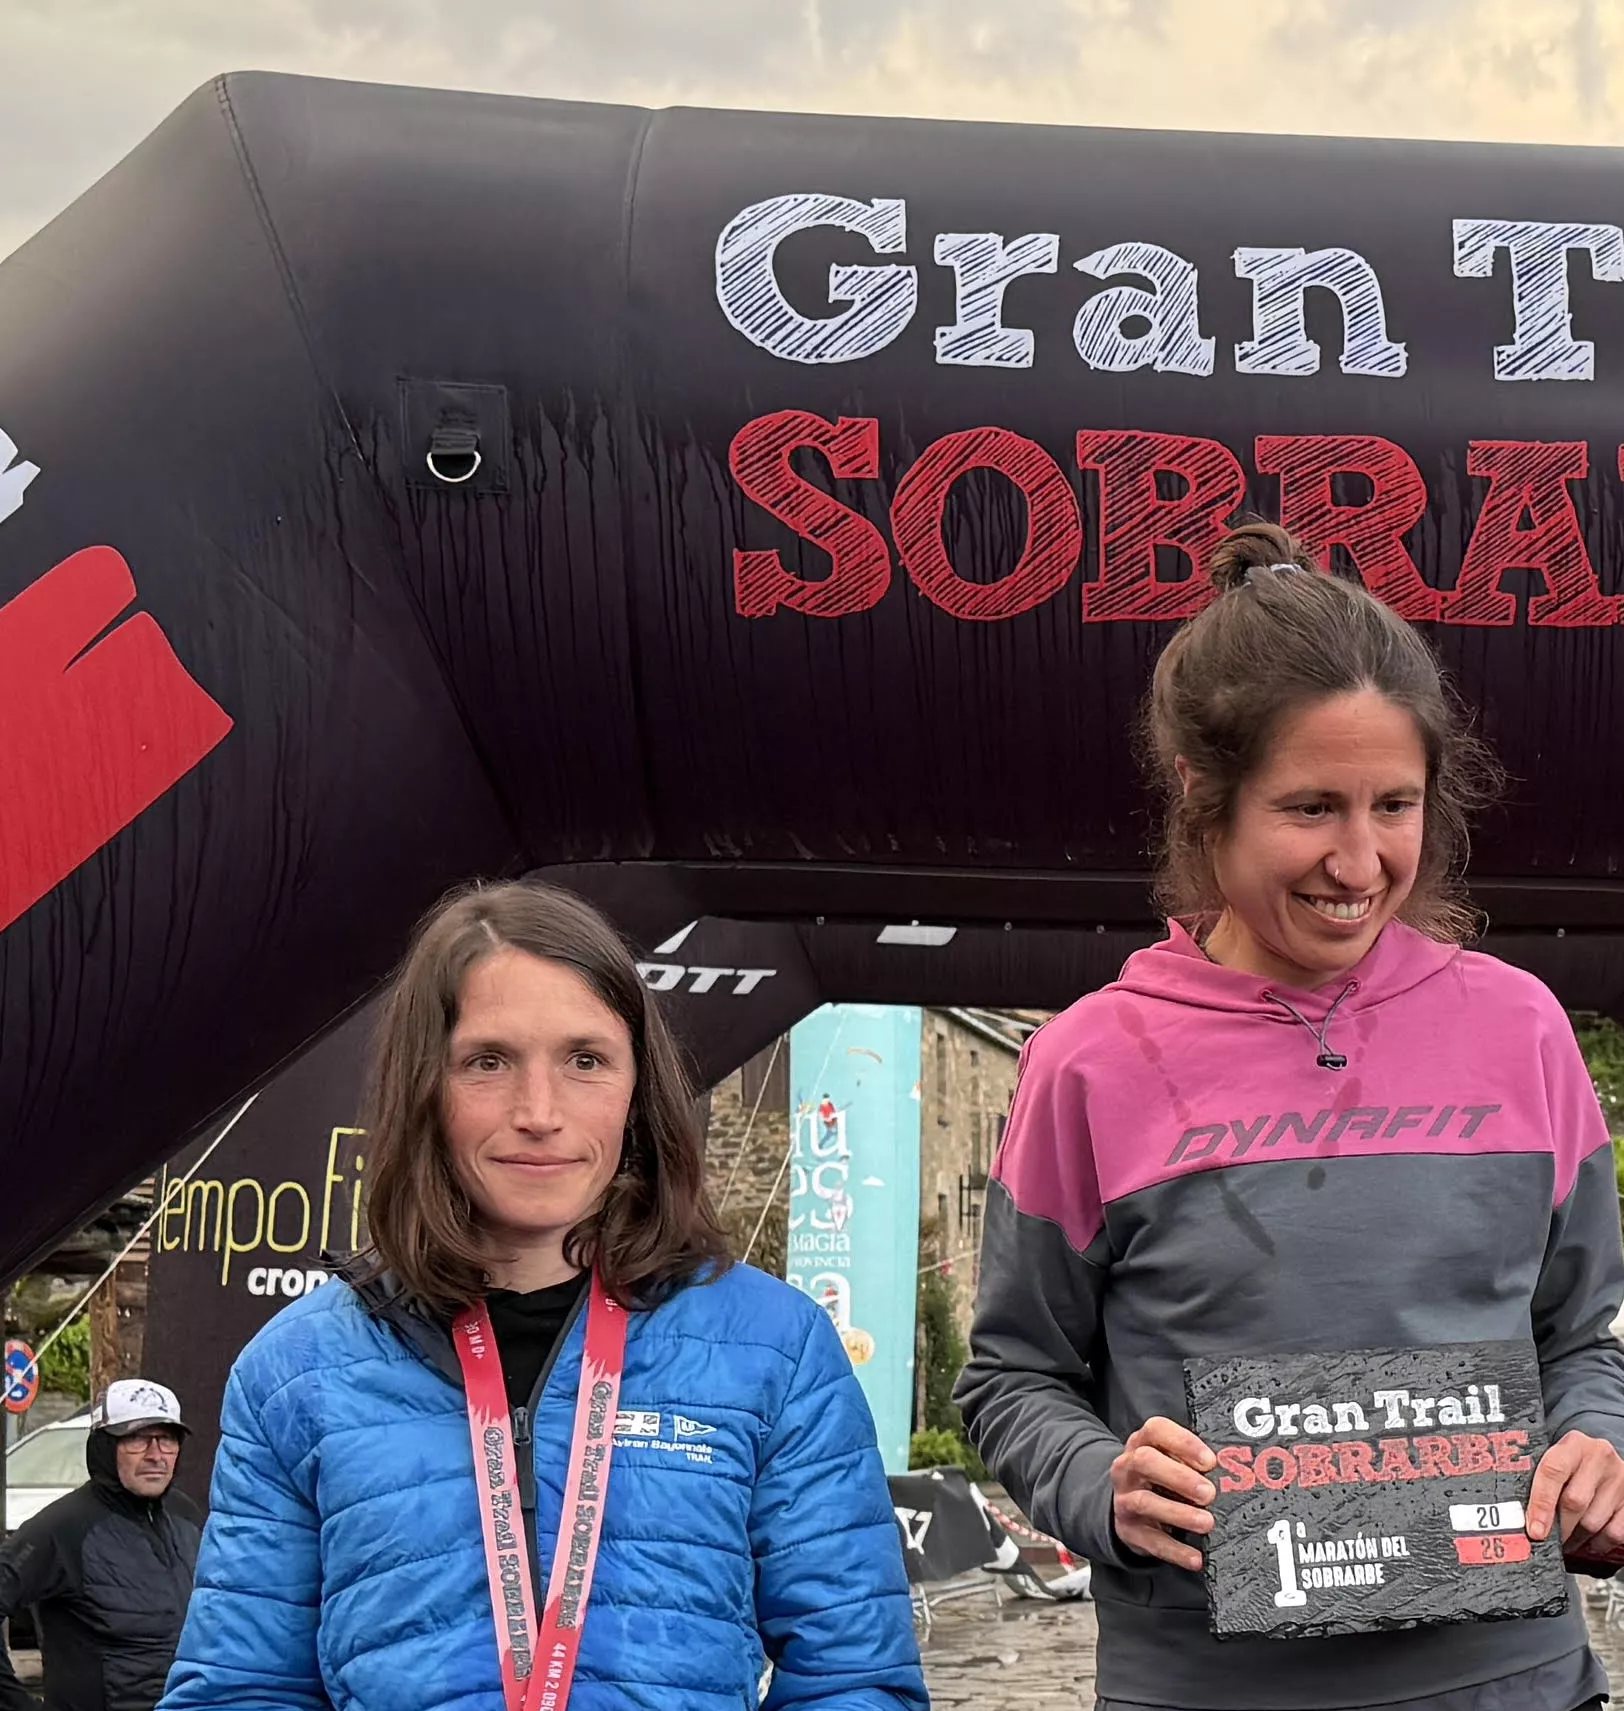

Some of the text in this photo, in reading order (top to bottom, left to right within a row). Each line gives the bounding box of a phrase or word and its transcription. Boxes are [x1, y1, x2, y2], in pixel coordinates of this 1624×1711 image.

[715, 194, 1407, 377] Gran
[635, 962, 777, 995] OTT
[1163, 1104, 1502, 1167] DYNAFIT
[1233, 1384, 1506, 1438] Gran Trail
[1215, 1430, 1532, 1494] SOBRARBE
[1476, 1506, 1501, 1529] 20
[1299, 1531, 1411, 1565] MARATÓN DEL
[1300, 1562, 1385, 1589] SOBRARBE
